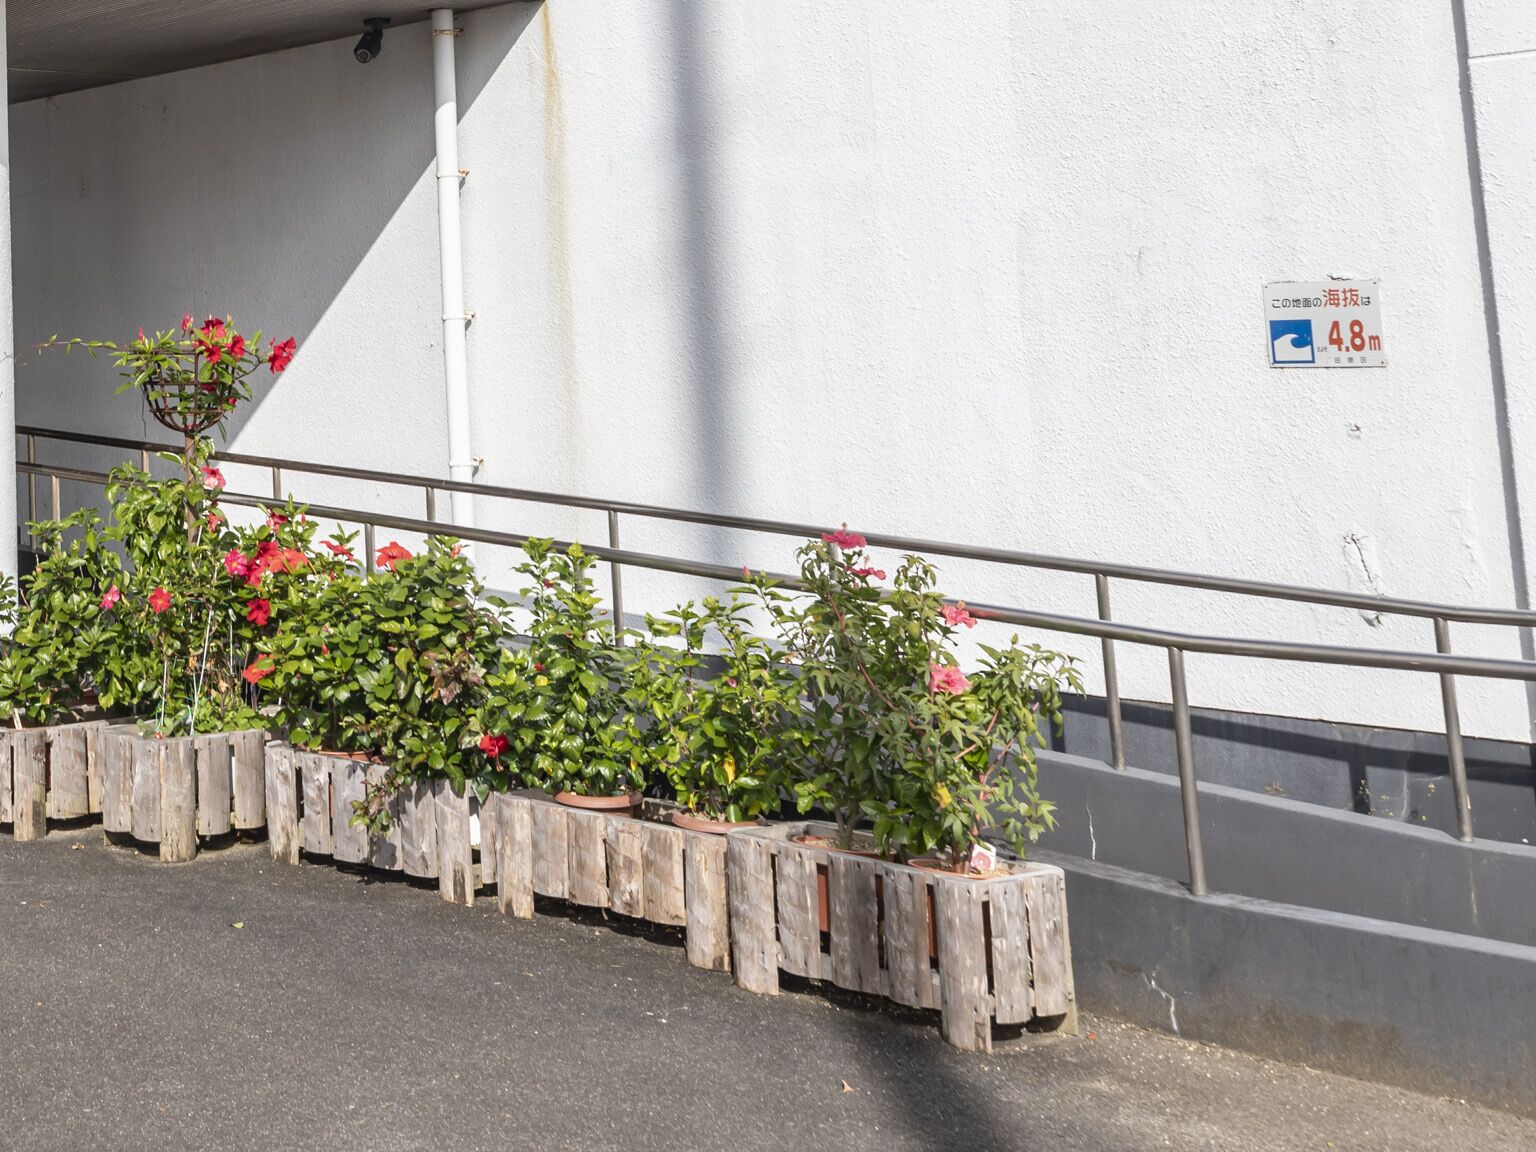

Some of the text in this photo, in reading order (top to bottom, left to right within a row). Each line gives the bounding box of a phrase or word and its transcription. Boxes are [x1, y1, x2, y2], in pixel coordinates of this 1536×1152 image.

[1271, 288, 1371, 309] この地面の海抜は
